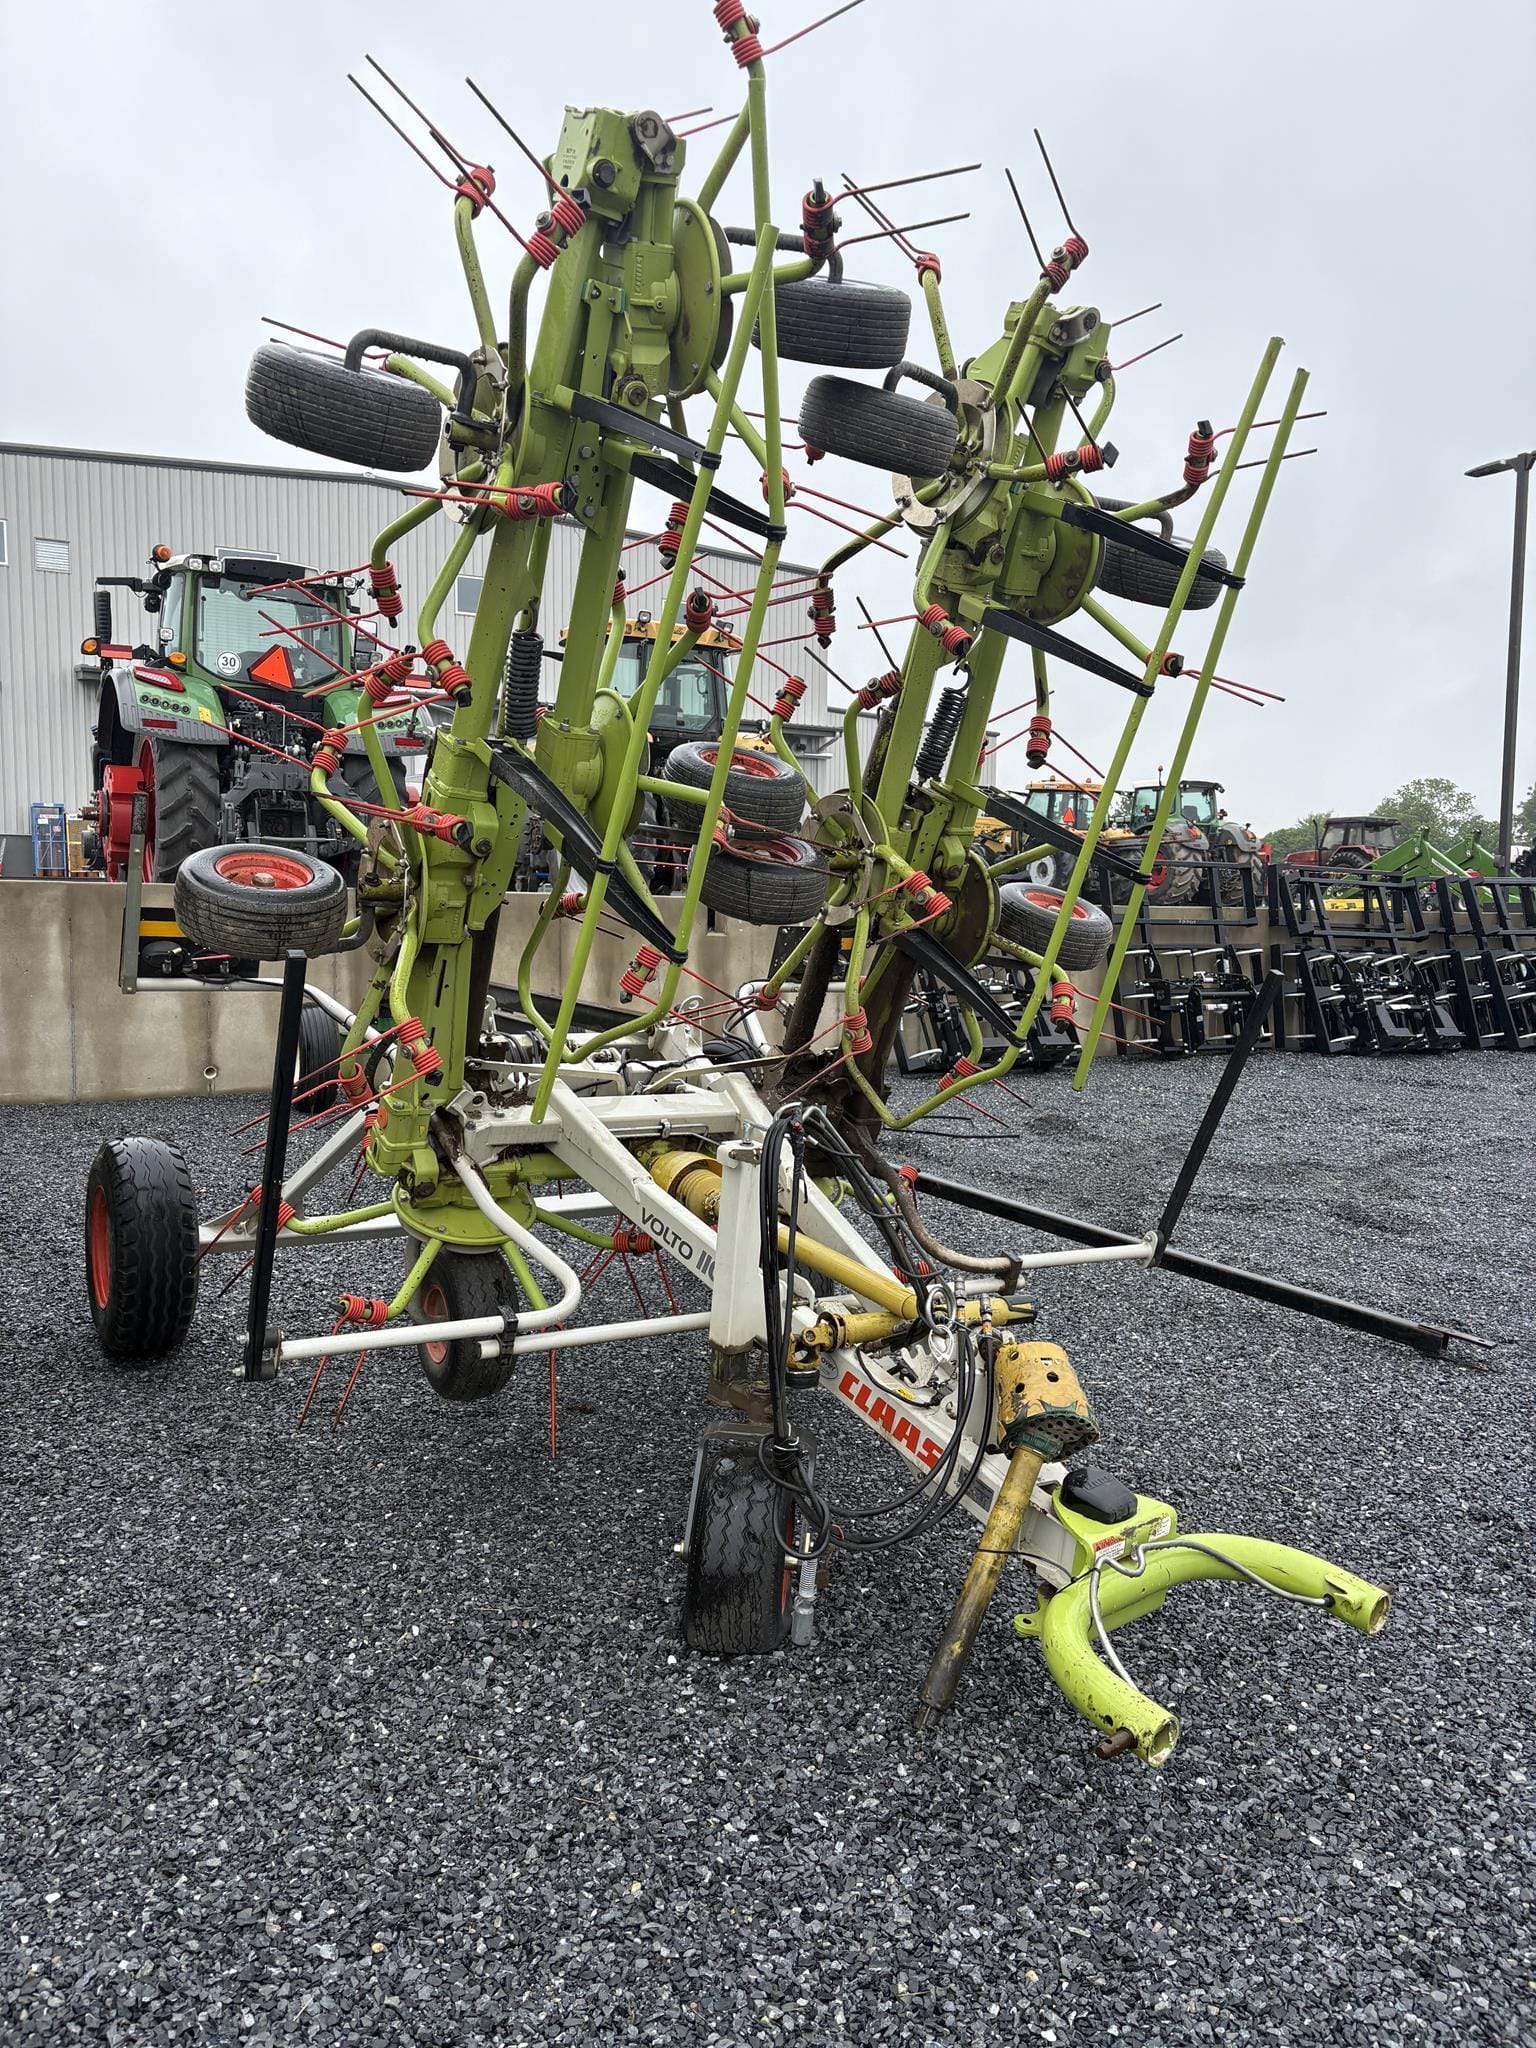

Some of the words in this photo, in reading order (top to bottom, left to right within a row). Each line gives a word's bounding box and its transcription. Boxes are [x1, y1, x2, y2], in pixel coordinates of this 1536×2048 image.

[221, 656, 236, 667] 30
[641, 1206, 693, 1260] VOLTO
[838, 1371, 944, 1470] CLAAS
